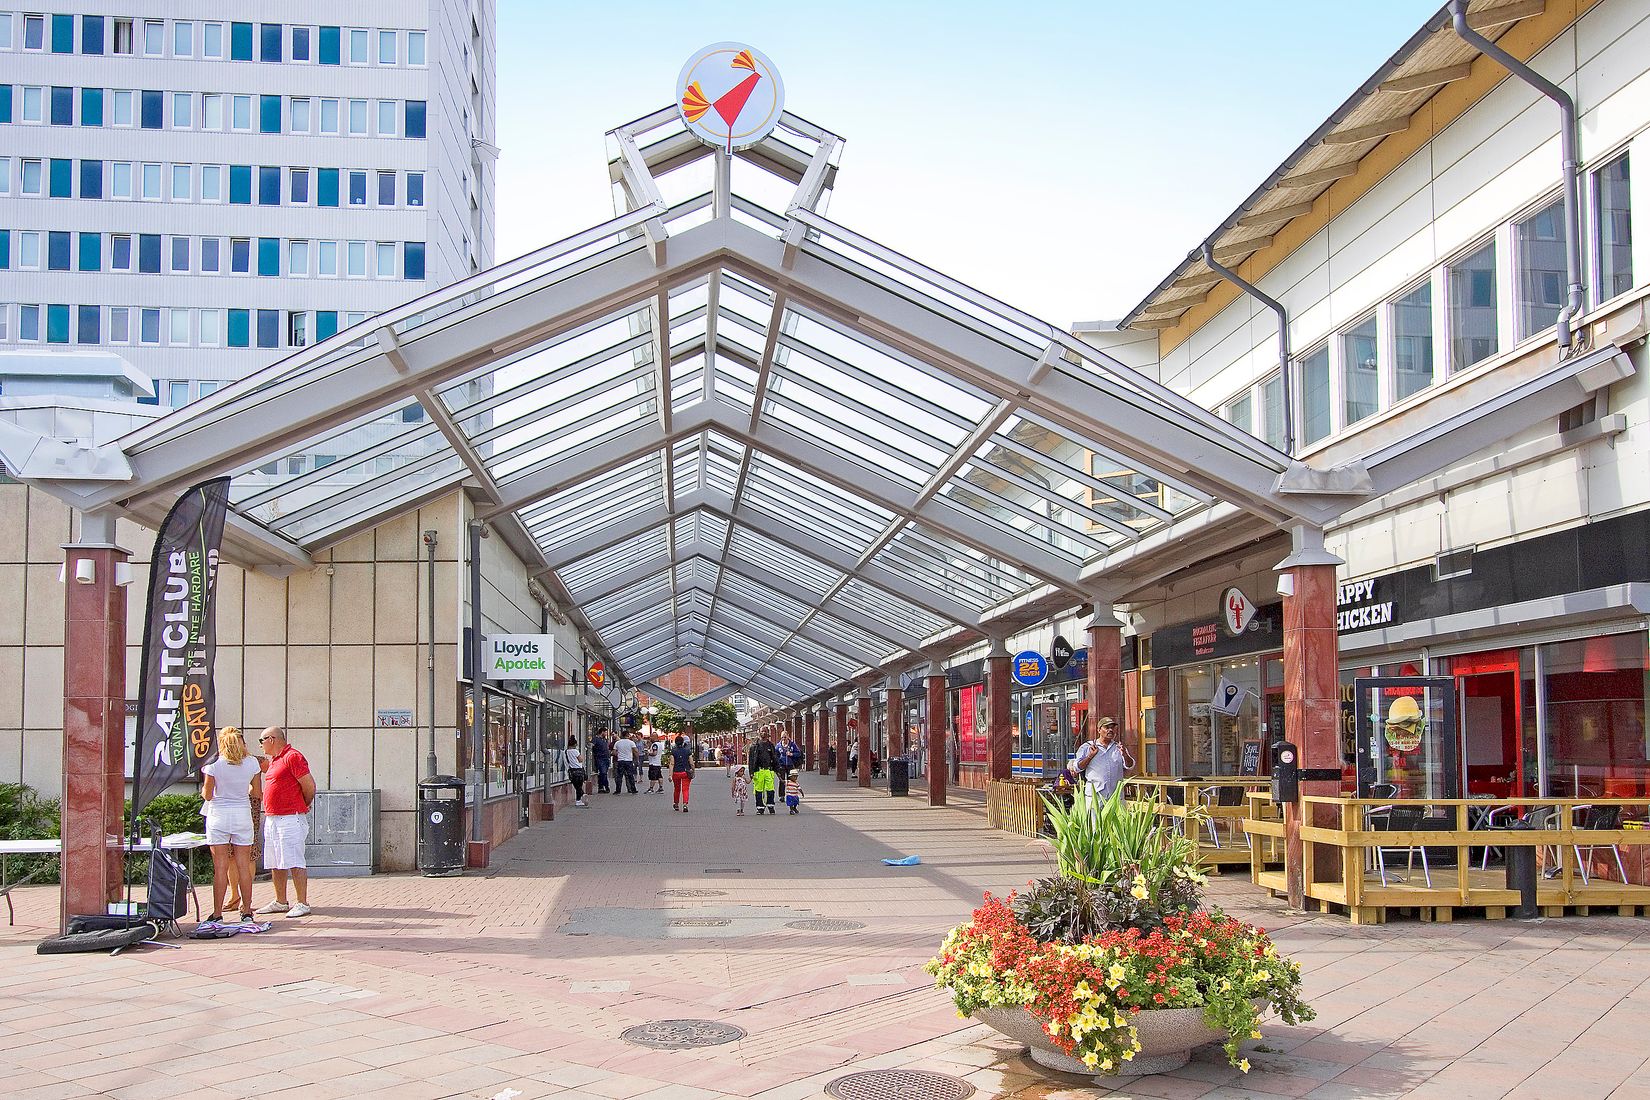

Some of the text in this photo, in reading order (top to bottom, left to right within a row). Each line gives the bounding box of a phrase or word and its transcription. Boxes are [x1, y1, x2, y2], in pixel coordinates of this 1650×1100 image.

[1337, 580, 1374, 606] APPY
[189, 615, 200, 643] INTE
[1337, 602, 1392, 631] HICKEN
[154, 551, 189, 767] 24FITCLUB
[494, 640, 539, 656] Lloyds
[494, 657, 546, 672] Apotek
[1019, 663, 1040, 671] 24
[182, 683, 212, 758] GRATIS
